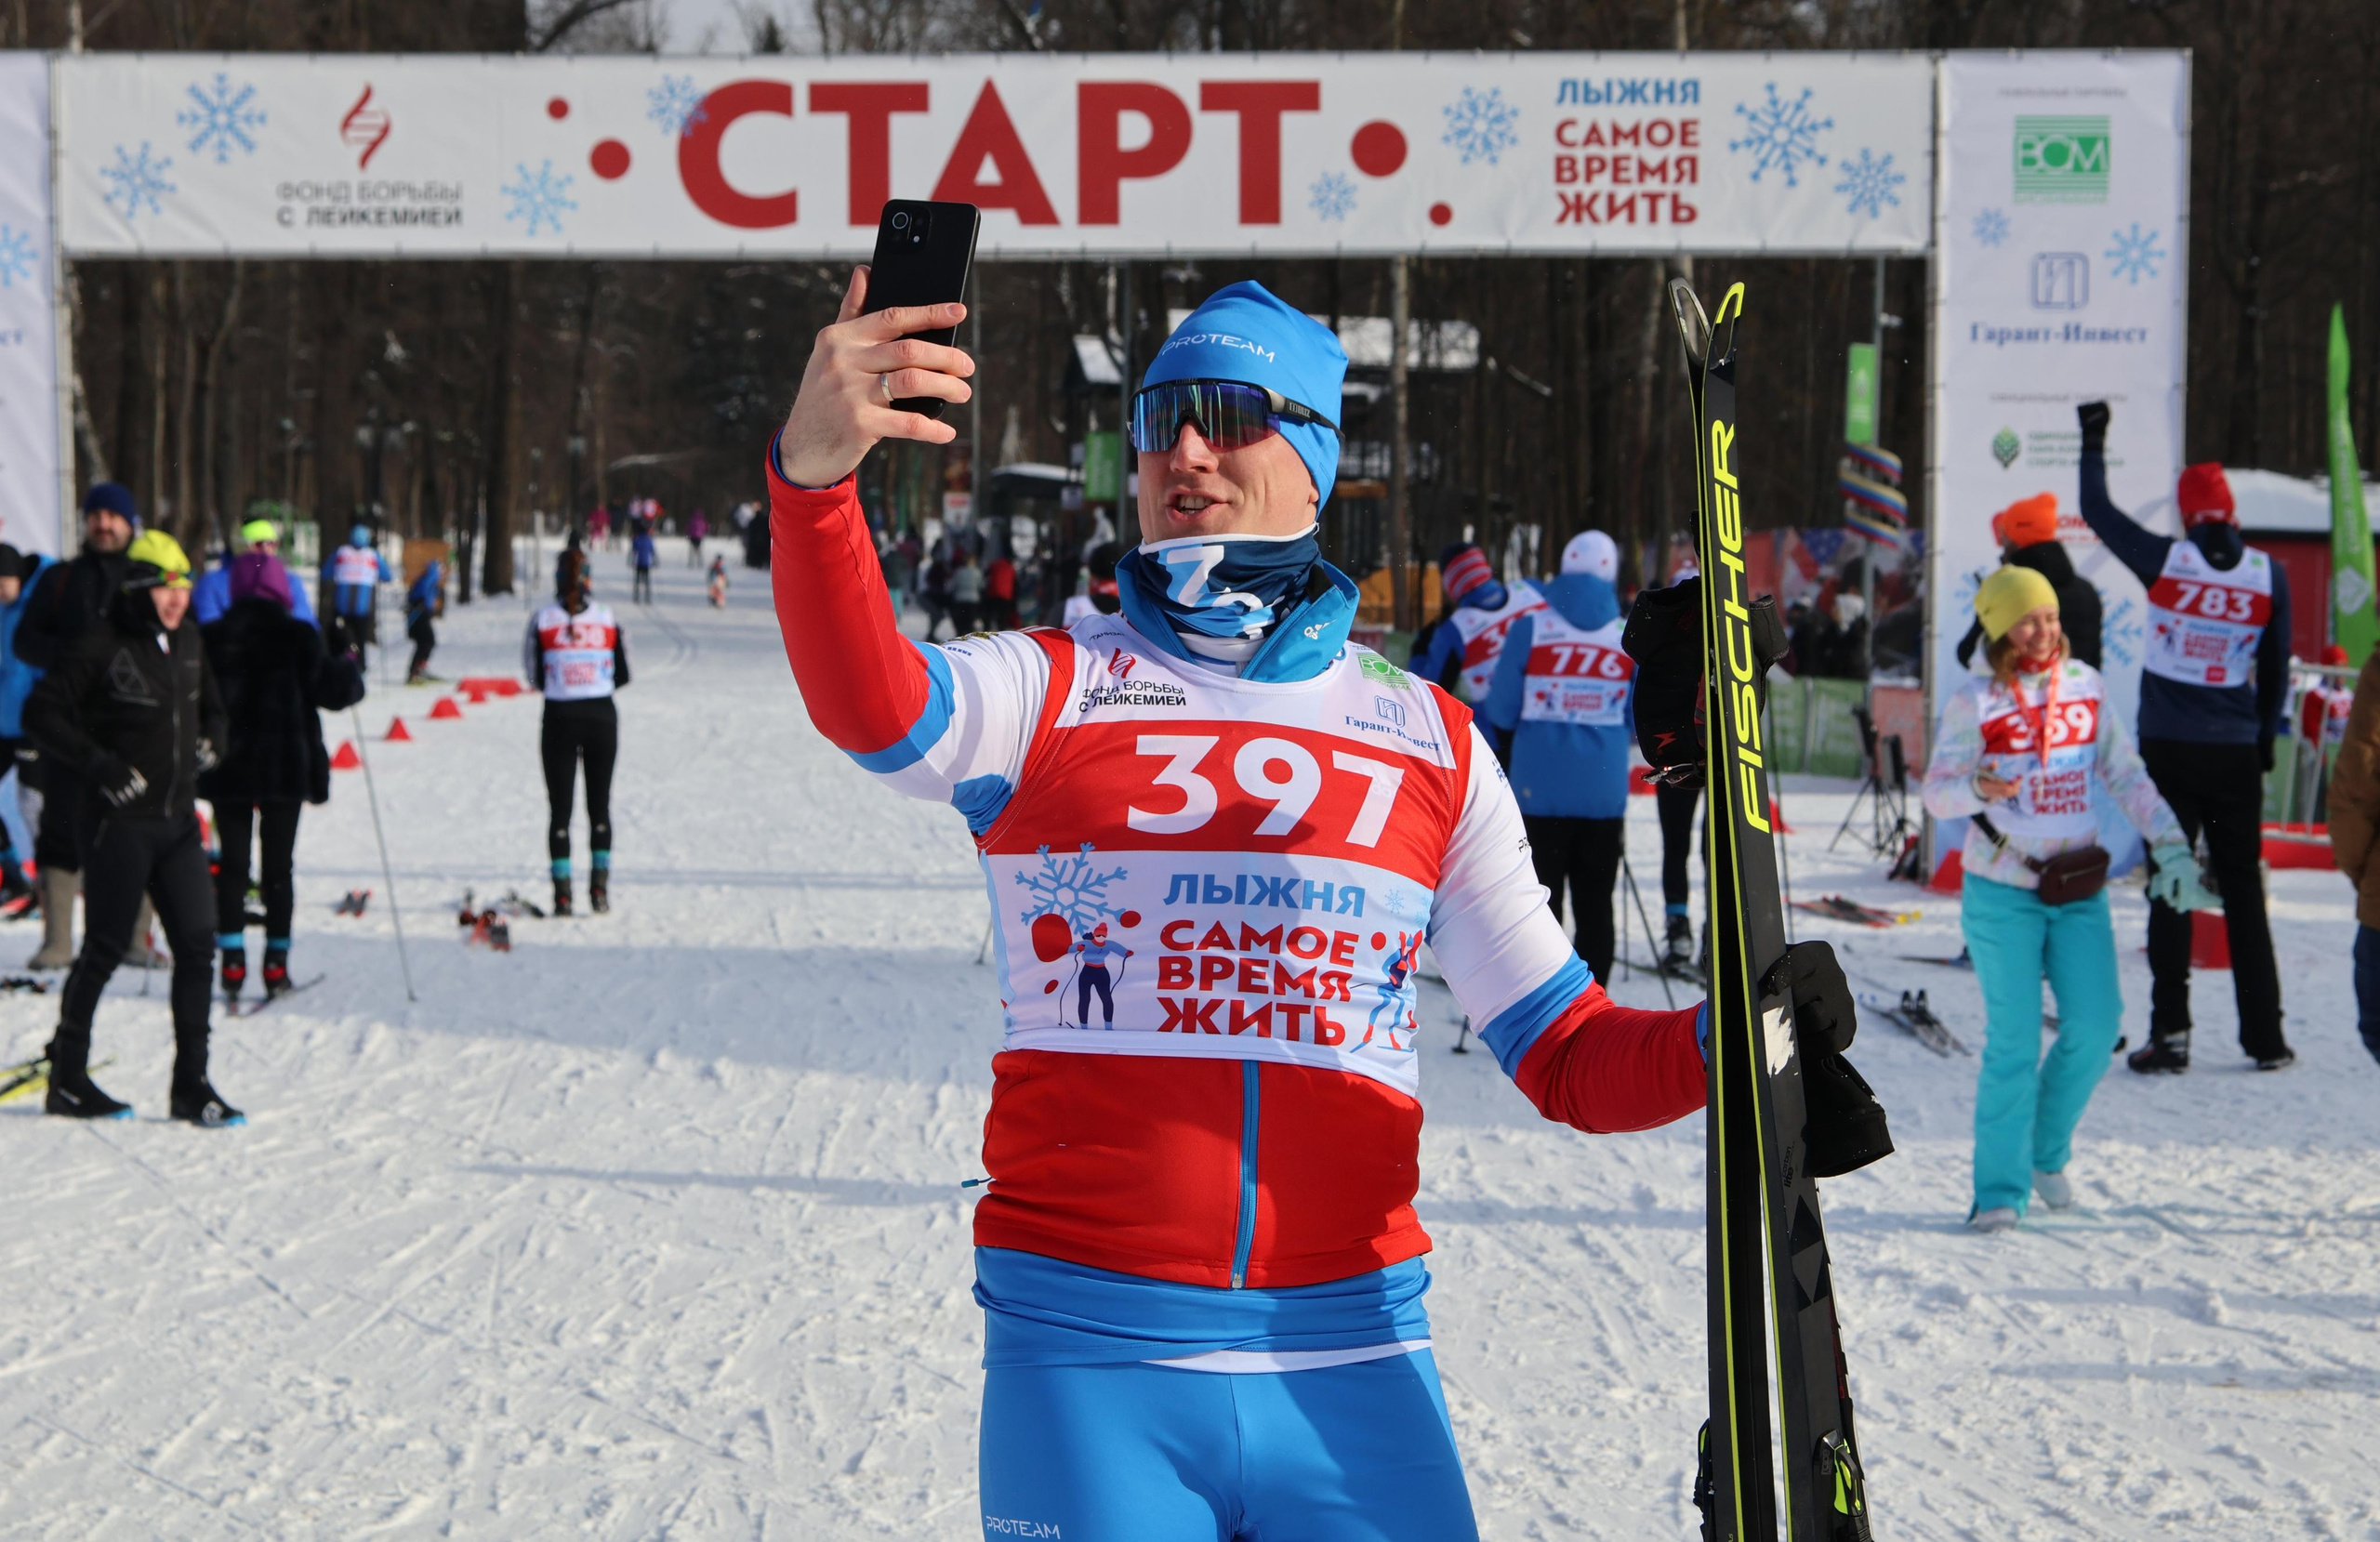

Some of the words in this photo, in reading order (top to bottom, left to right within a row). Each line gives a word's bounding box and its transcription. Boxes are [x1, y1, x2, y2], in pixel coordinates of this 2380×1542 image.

[1555, 79, 1699, 105] ЛЫЖНЯ
[1554, 118, 1700, 148] САМОЕ
[675, 77, 1321, 229] СТАРТ
[1554, 154, 1699, 184] ВРЕМЯ
[276, 180, 352, 204] ФОНД
[357, 180, 463, 204] БОРЬБЫ
[1555, 191, 1699, 224] ЖИТЬ
[277, 205, 296, 229] С
[1161, 333, 1276, 363] PROTEAM
[1970, 323, 2148, 347] Гарант-Инвест
[2174, 581, 2254, 621] 783
[1711, 419, 1770, 835] FISCHER
[1550, 645, 1625, 679] 776
[1078, 701, 1090, 713] С
[1092, 692, 1187, 707] ЛЕЙКЕМИЕЙ
[1082, 685, 1120, 699] ФОНД
[1123, 679, 1185, 697] БОРЬБЫ
[1127, 734, 1406, 850] 397
[1162, 874, 1366, 918] ЛЫЖНЯ
[1159, 919, 1359, 968] САМОЕ
[1157, 955, 1353, 1003] ВРЕМЯ
[1156, 996, 1346, 1047] ЖИТЬ
[985, 1515, 1062, 1540] PROTEAM
